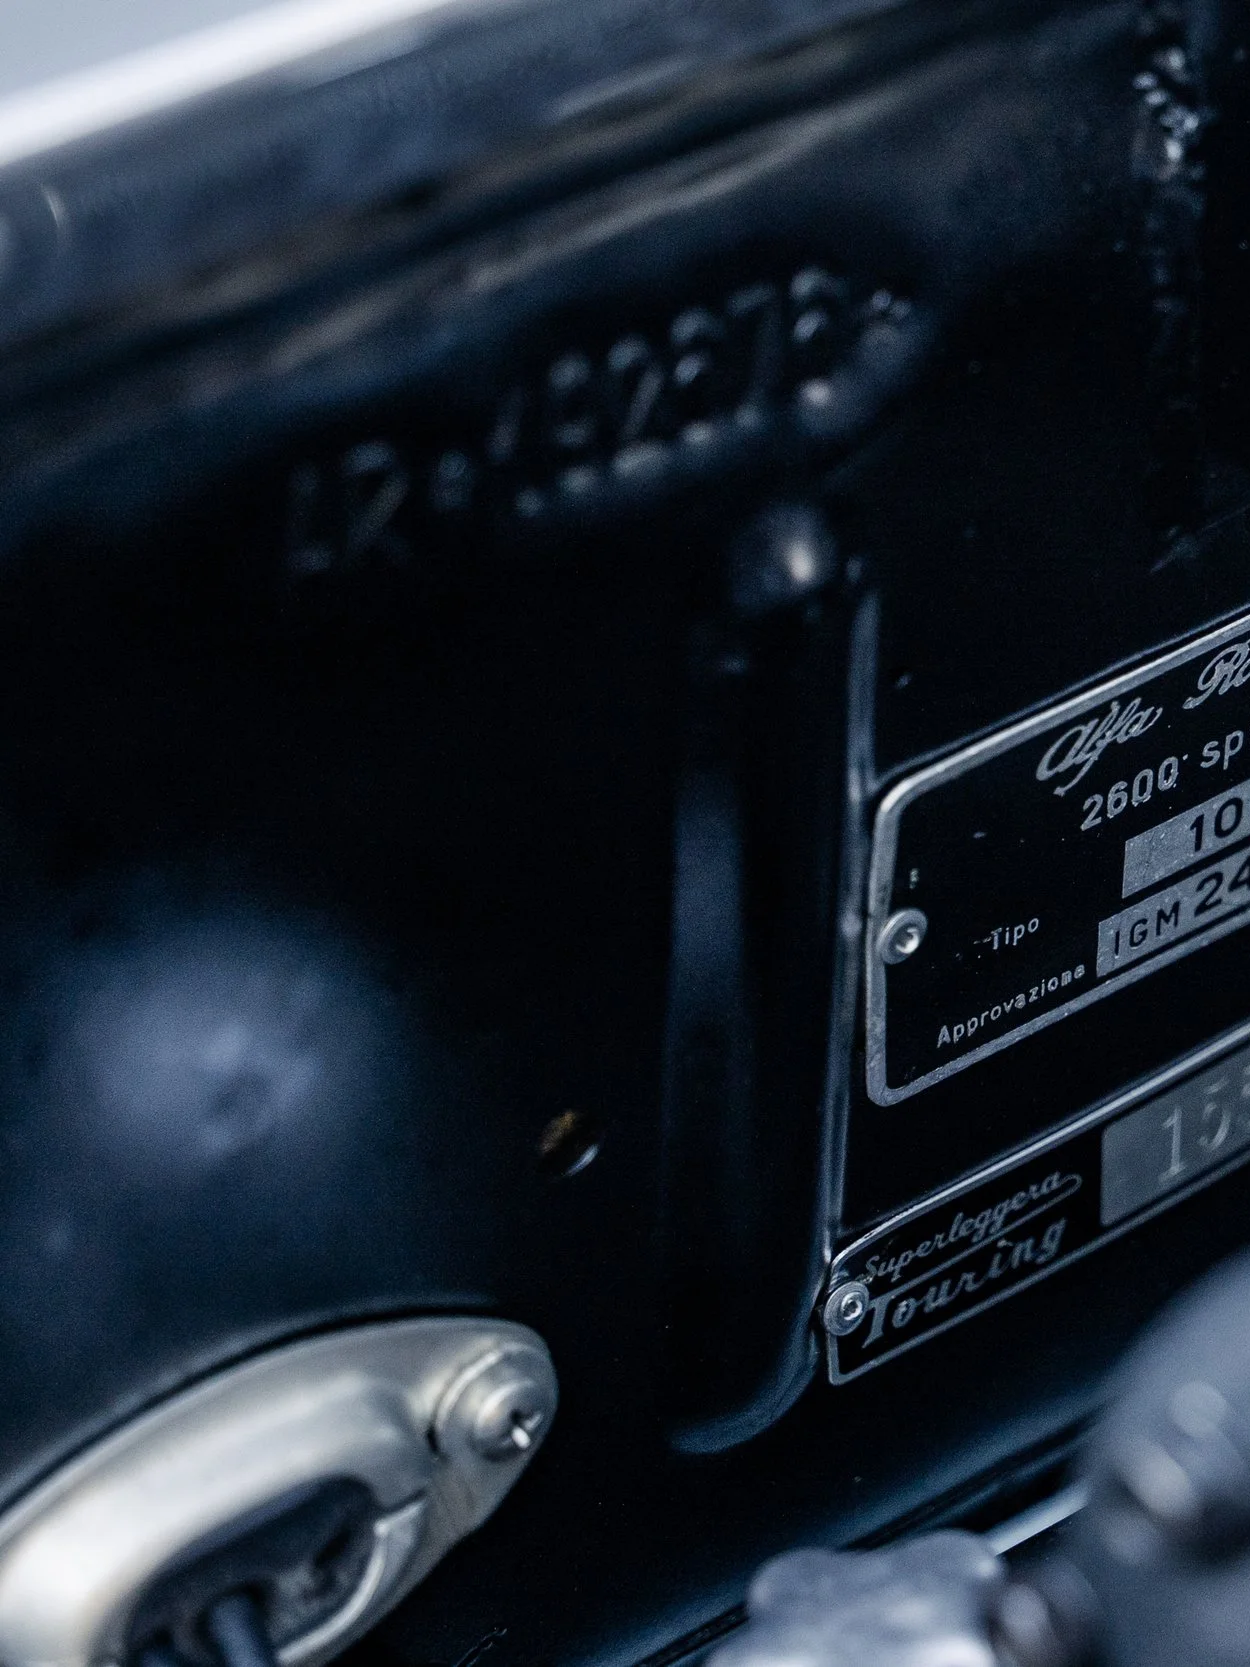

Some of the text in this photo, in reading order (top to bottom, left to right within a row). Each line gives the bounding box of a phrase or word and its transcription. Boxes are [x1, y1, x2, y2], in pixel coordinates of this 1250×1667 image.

[1036, 697, 1163, 797] Alfa
[1080, 756, 1180, 831] 2600
[936, 964, 1085, 1048] Approvazione
[1113, 901, 1181, 957] IGM
[991, 917, 1040, 950] Tipo
[857, 1171, 1068, 1284] Superleggera
[862, 1217, 1068, 1349] Touring
